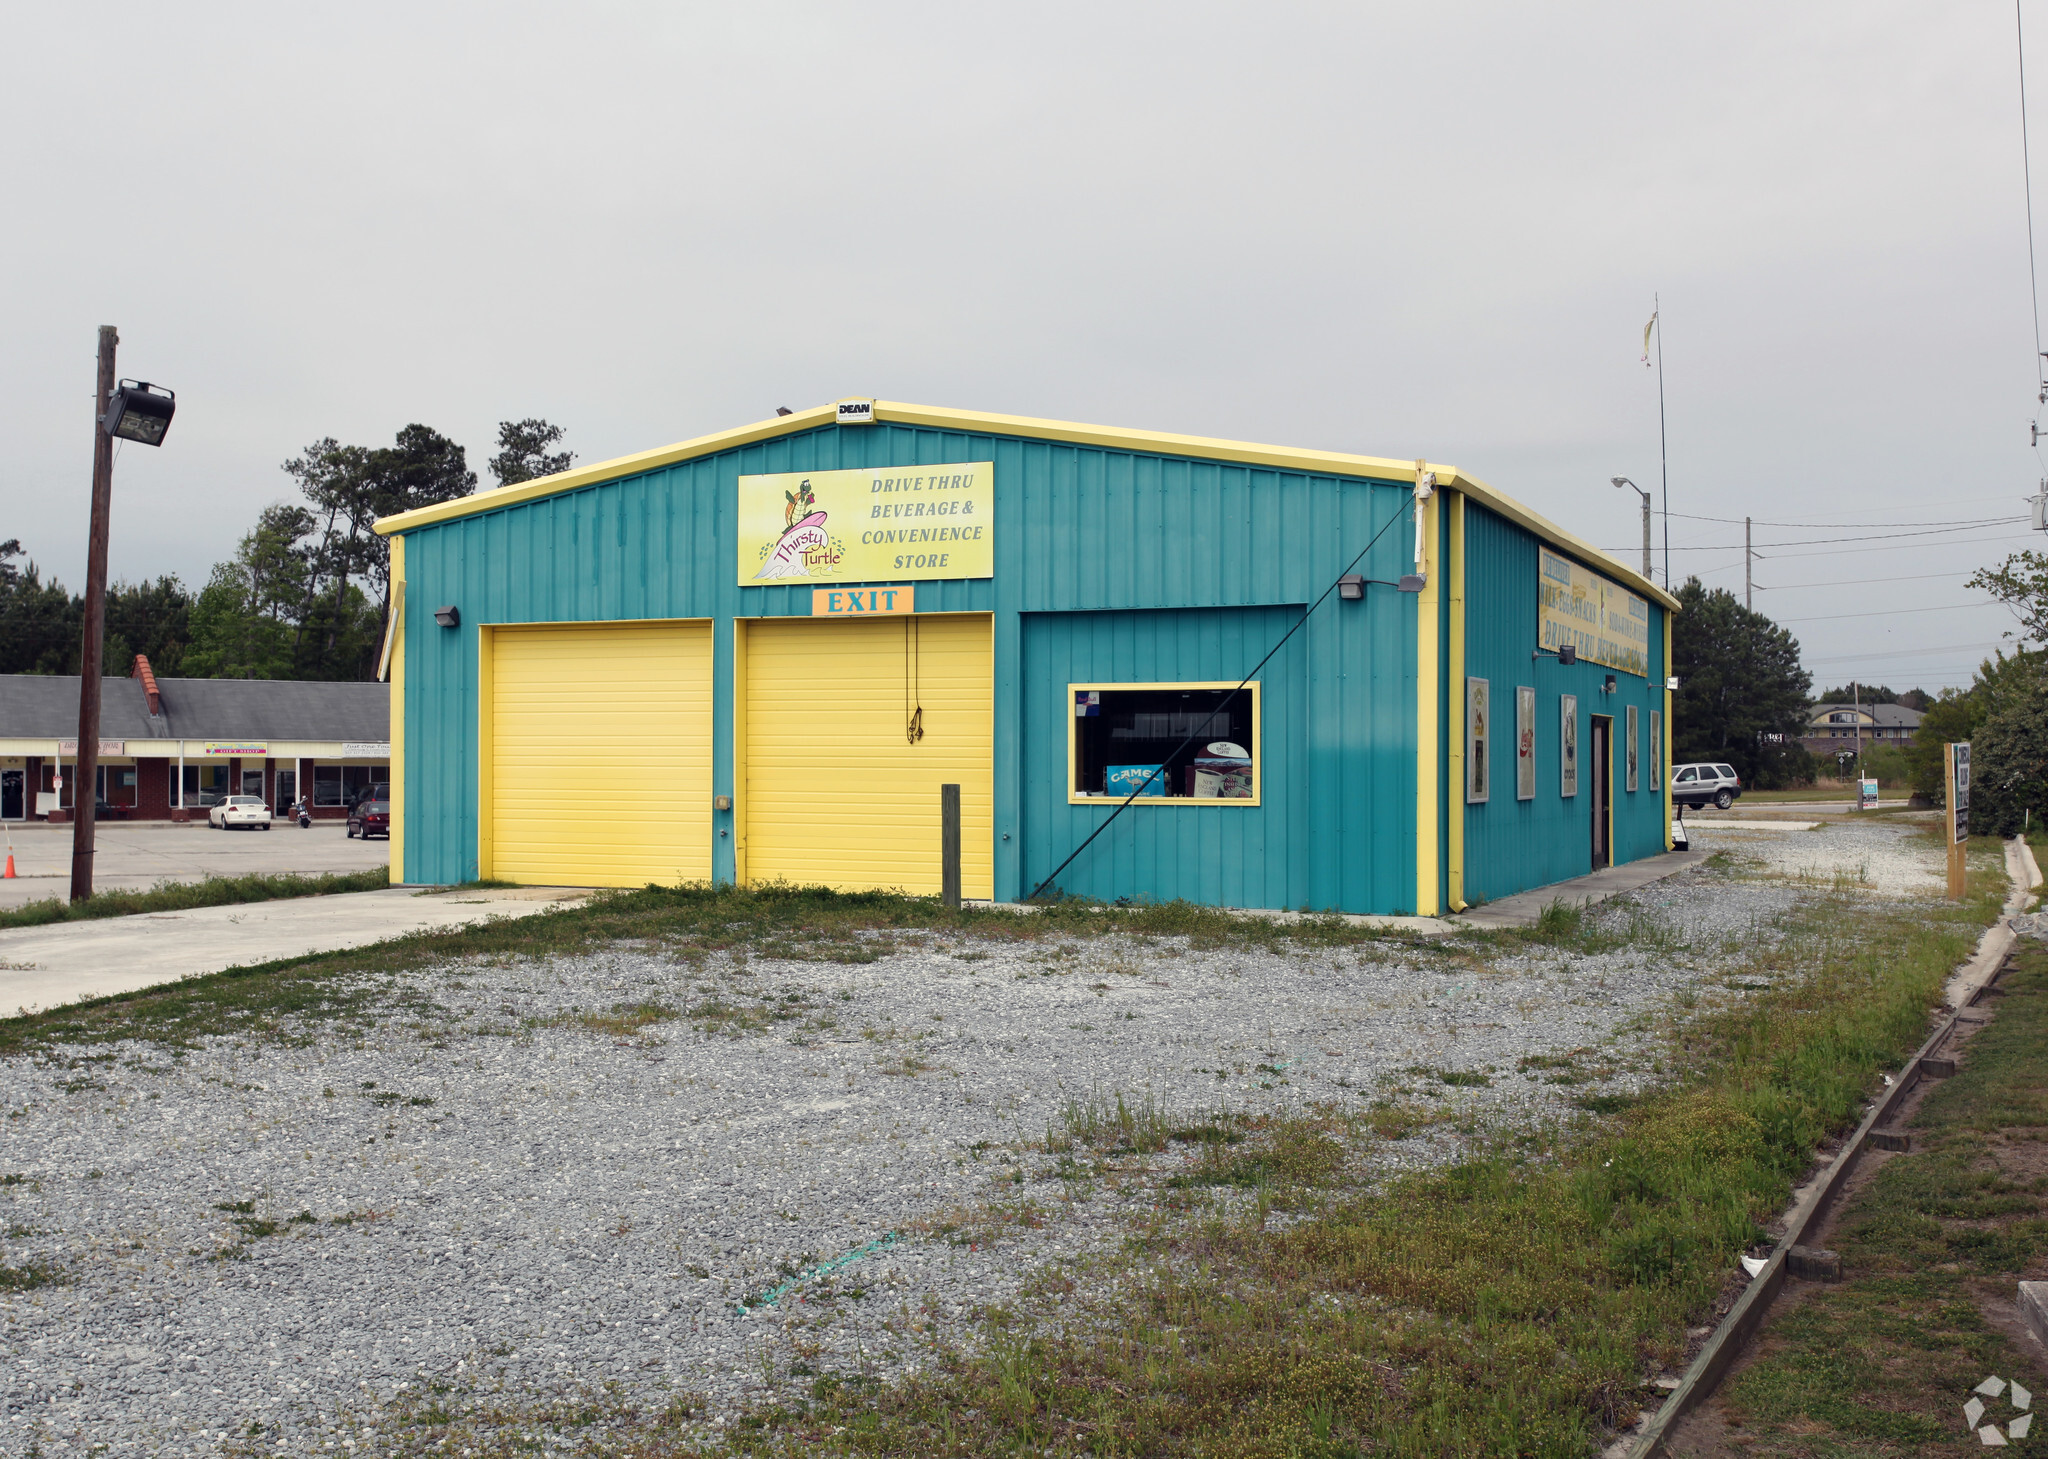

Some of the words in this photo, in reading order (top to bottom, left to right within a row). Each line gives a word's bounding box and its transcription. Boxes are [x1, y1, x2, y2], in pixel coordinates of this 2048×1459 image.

[839, 404, 870, 414] DEAN
[871, 477, 923, 493] DRIVE
[928, 474, 974, 490] THRU
[871, 502, 958, 519] BEVERAGE
[962, 500, 974, 514] &
[862, 526, 983, 545] CONVENIENCE
[773, 530, 825, 563] Thirsty
[799, 547, 841, 568] Turtle
[894, 553, 949, 569] STORE
[828, 590, 898, 612] EXIT
[1545, 619, 1572, 647] DRIVE
[1573, 629, 1596, 658] THRU
